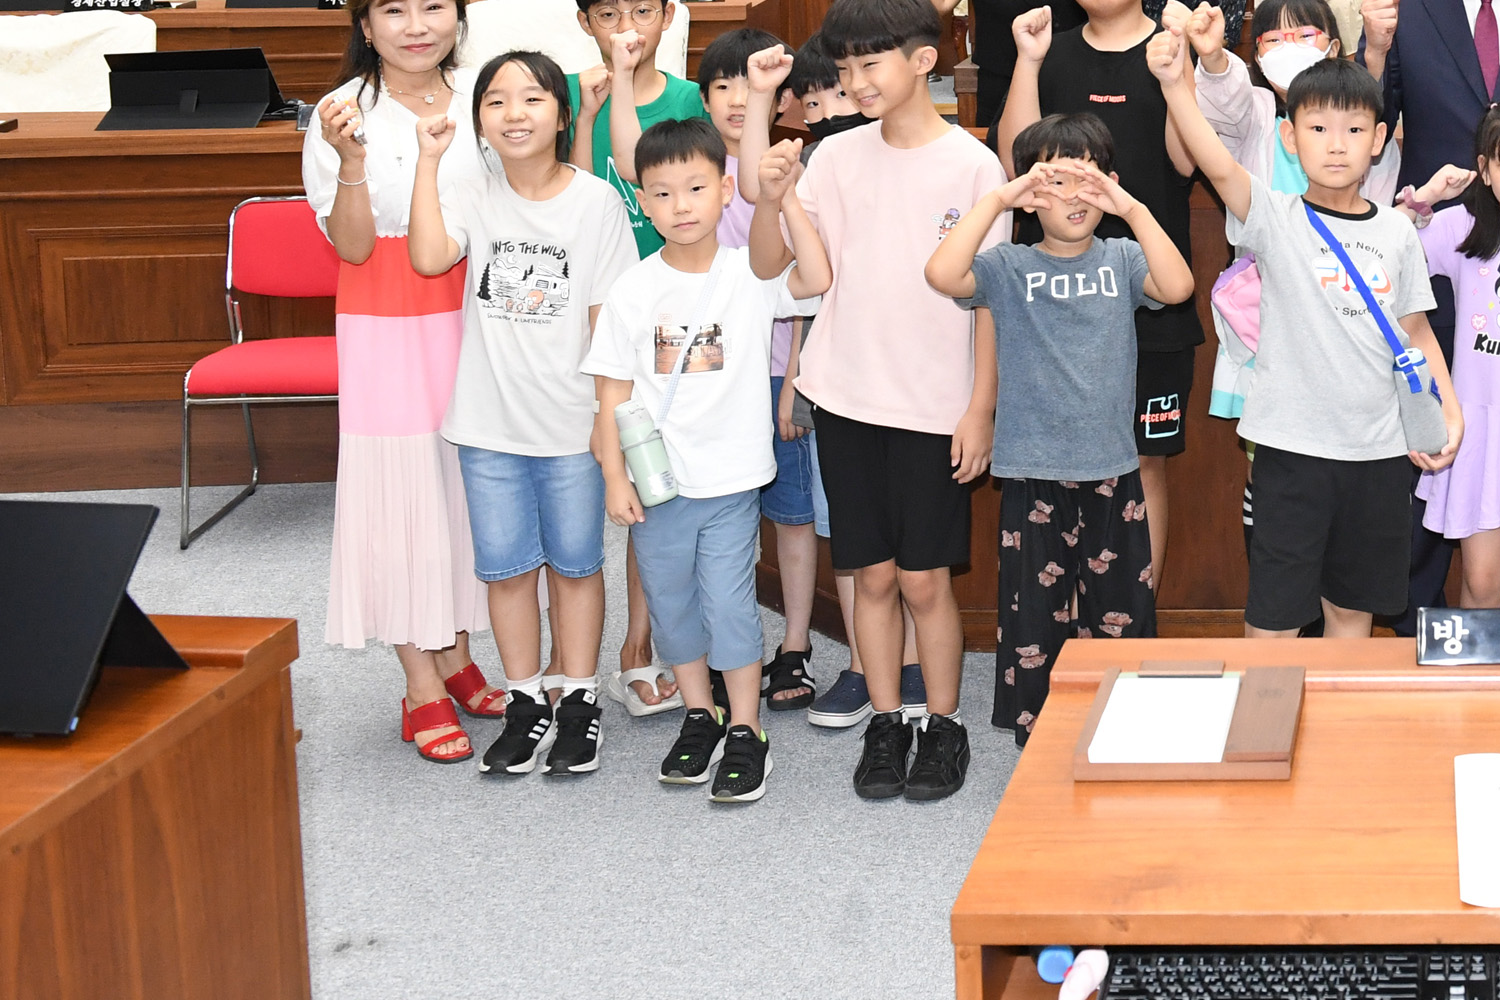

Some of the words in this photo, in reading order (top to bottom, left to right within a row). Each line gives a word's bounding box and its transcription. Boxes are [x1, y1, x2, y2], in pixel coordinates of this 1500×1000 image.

[492, 240, 515, 255] INTO
[518, 242, 540, 254] THE
[540, 244, 566, 260] WILD
[1356, 241, 1384, 260] Nella
[1025, 266, 1119, 302] POLO
